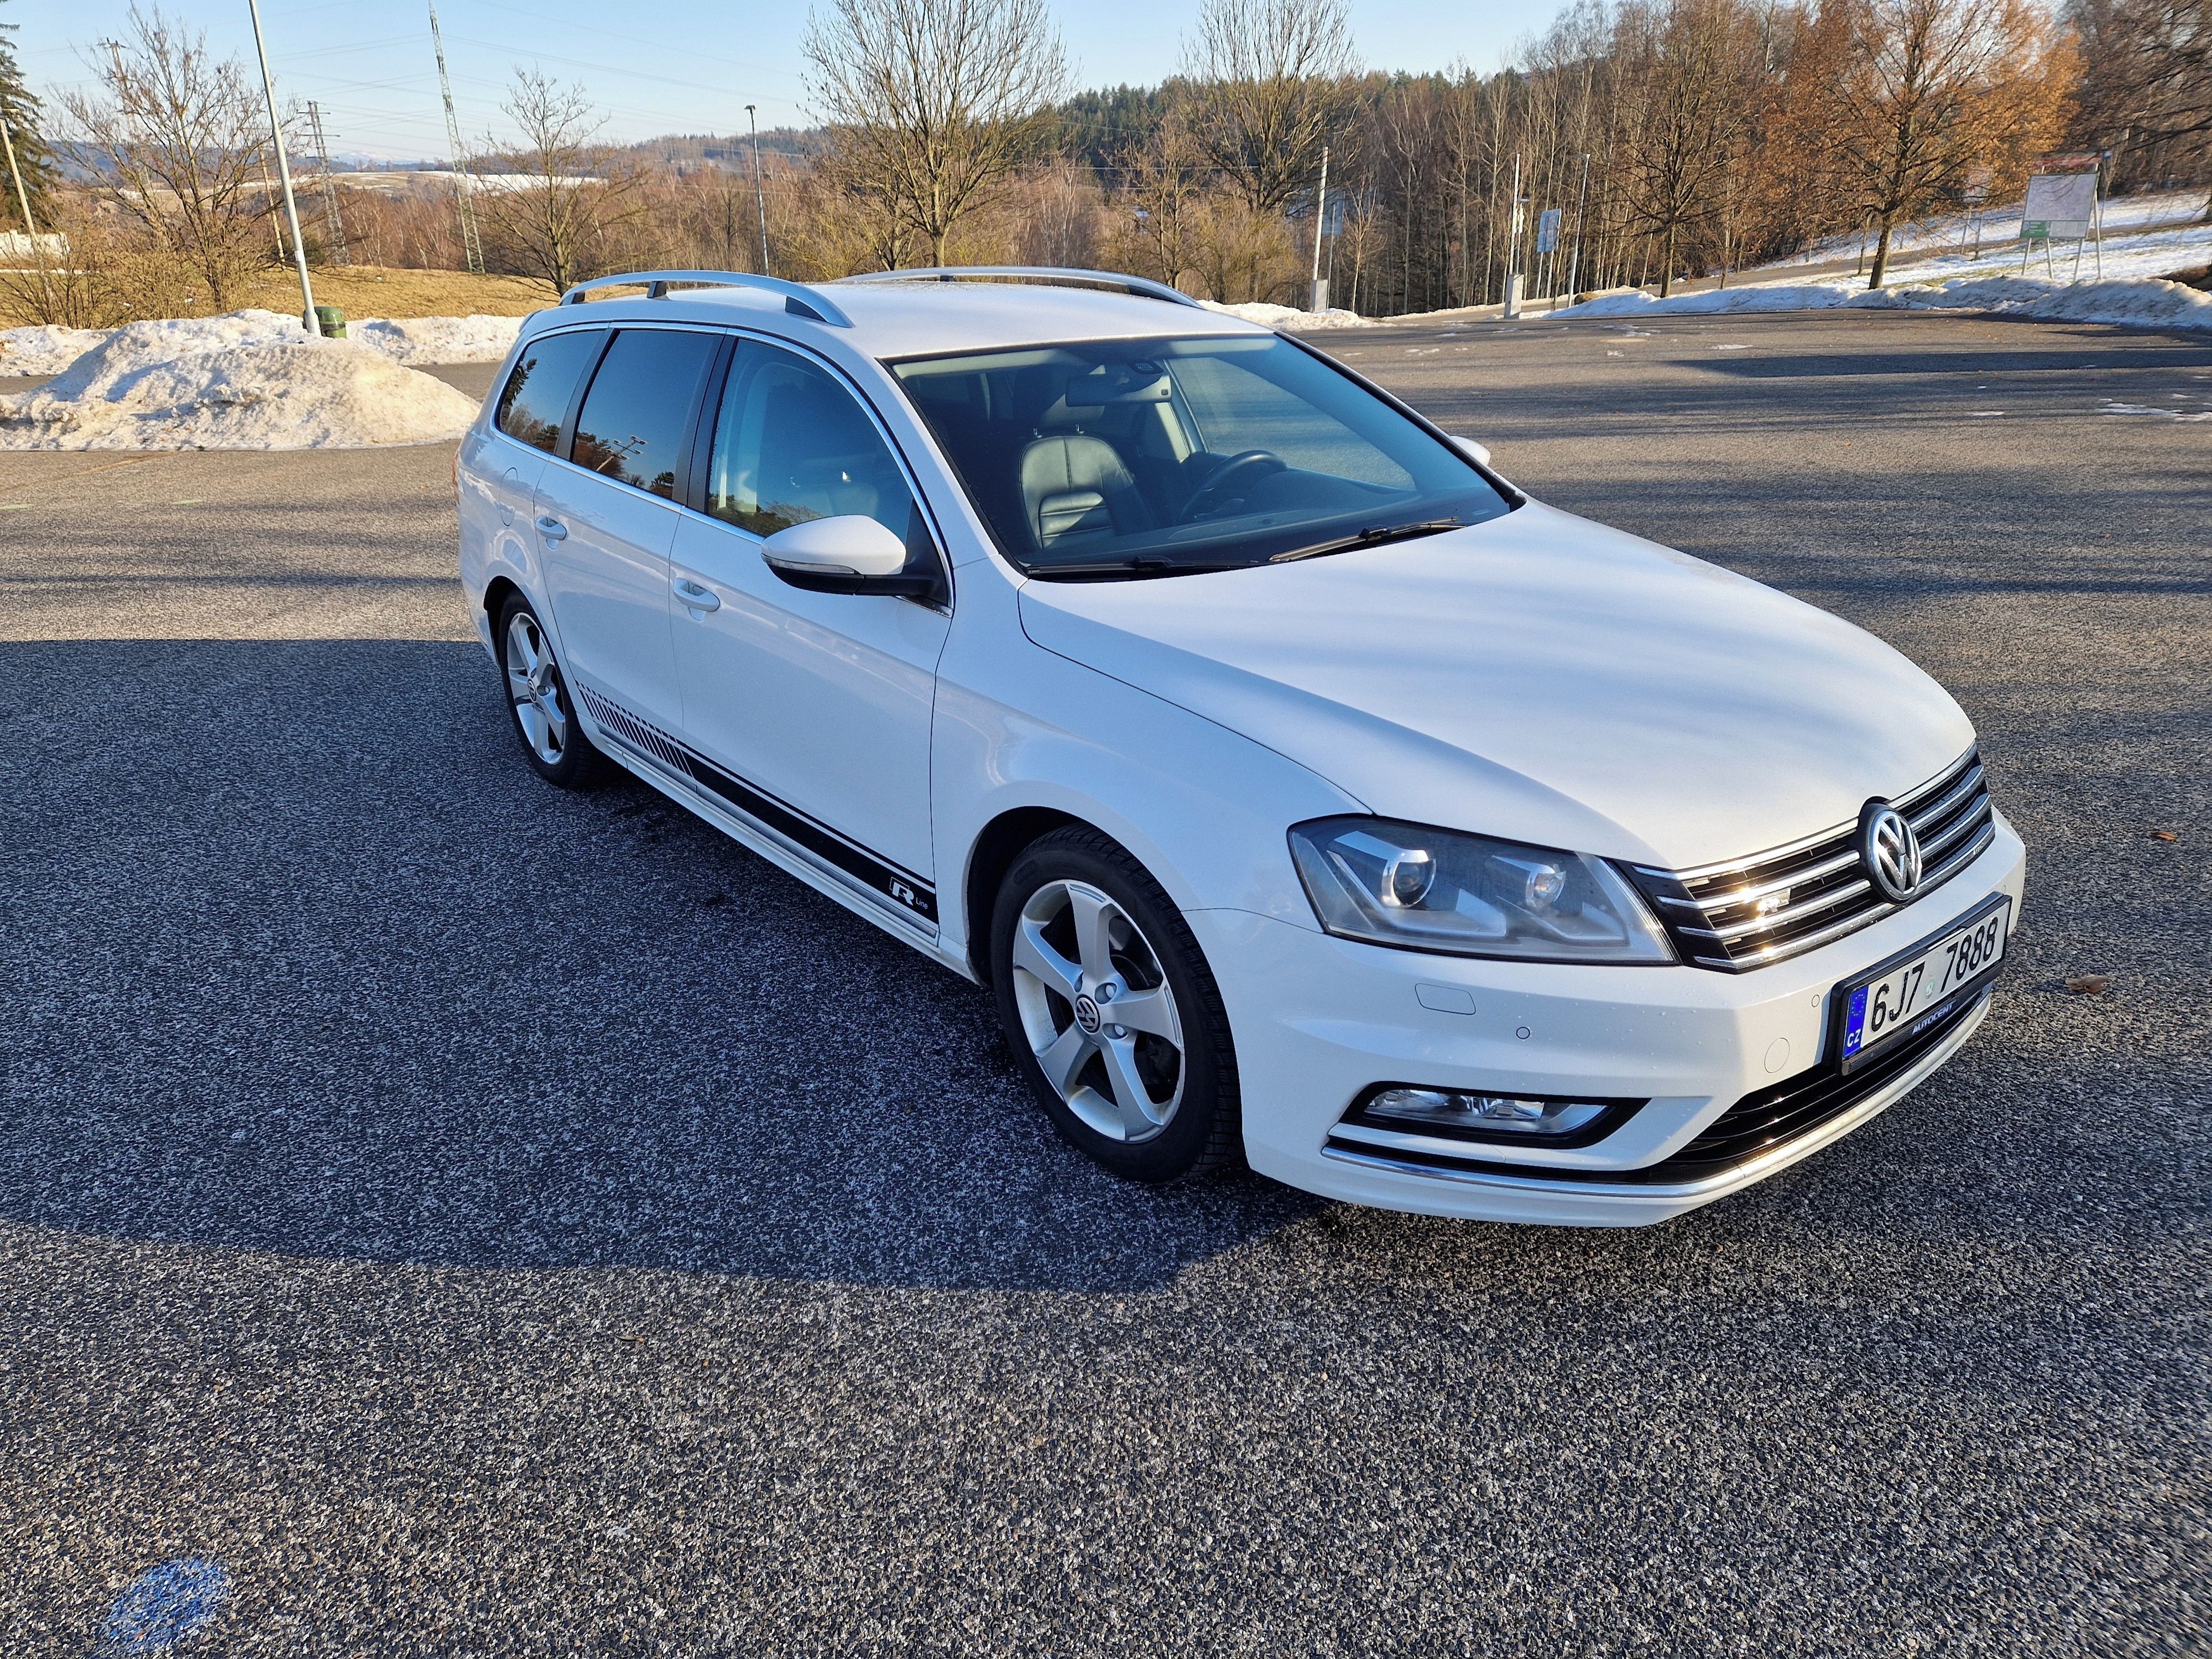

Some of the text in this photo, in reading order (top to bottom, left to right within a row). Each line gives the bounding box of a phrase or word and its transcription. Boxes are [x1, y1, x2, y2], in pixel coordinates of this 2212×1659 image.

[889, 877, 928, 909] R Line
[1871, 916, 1998, 1032] 6J7 7888
[1847, 1028, 1861, 1047] CZ
